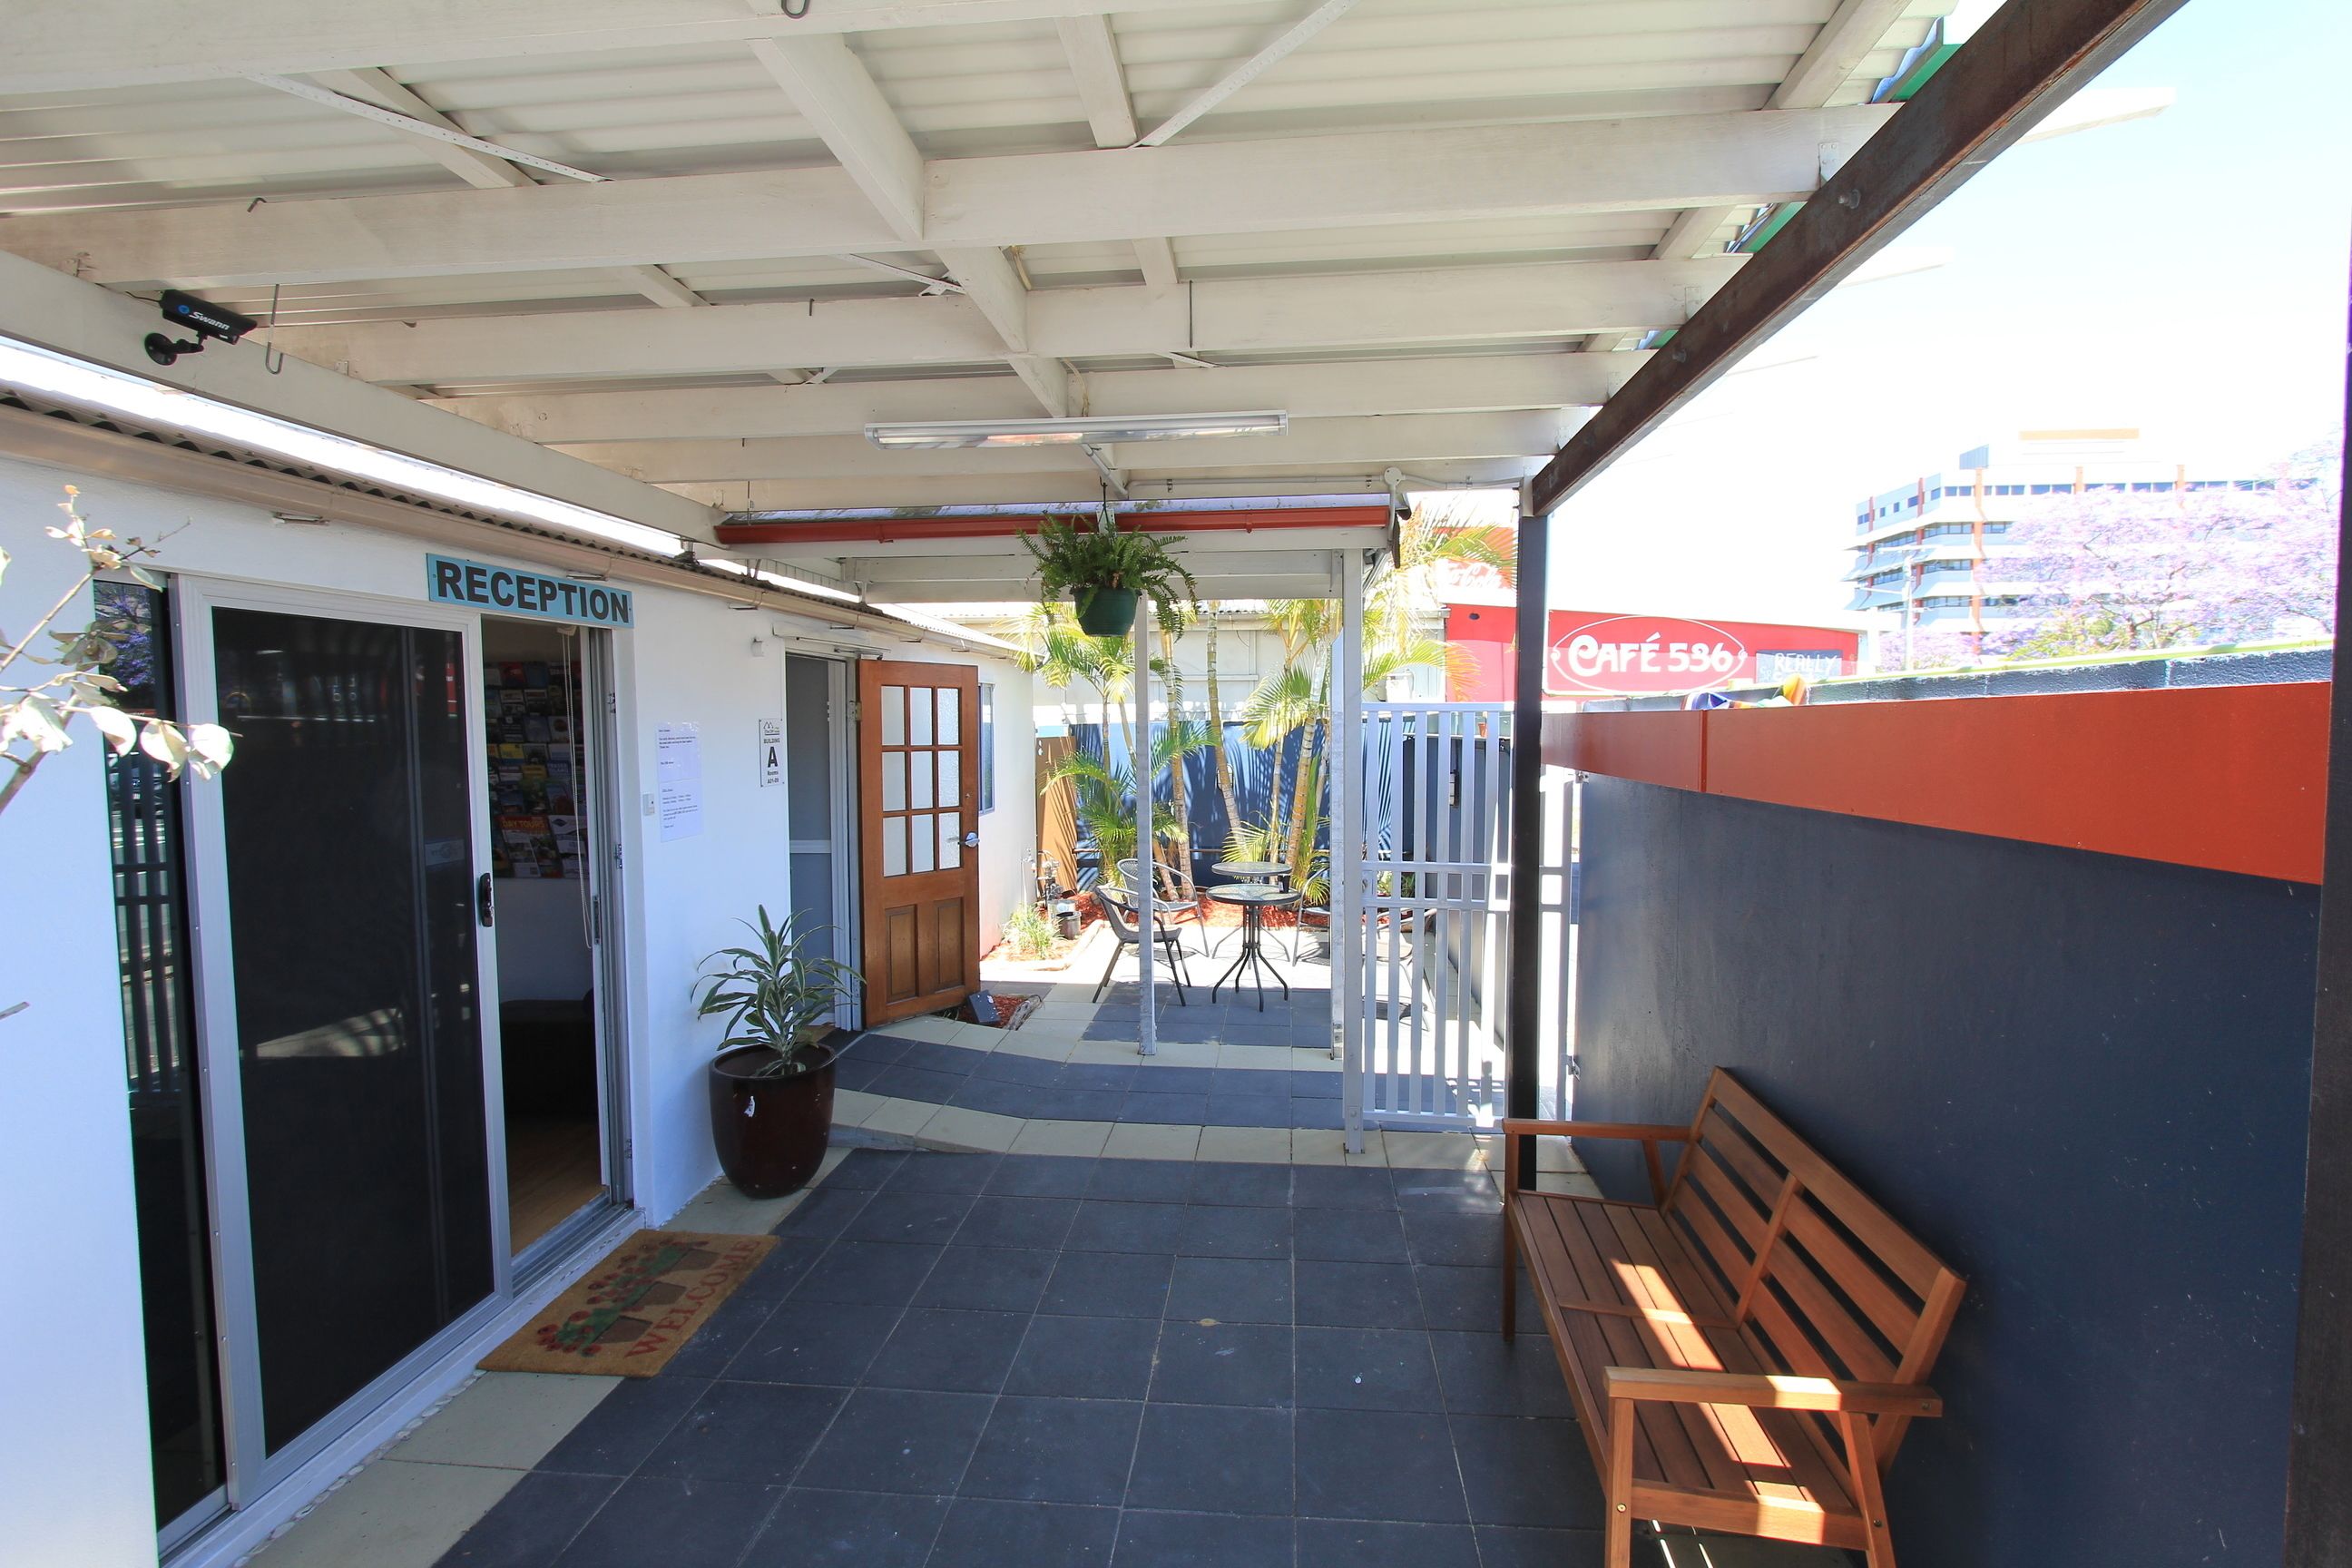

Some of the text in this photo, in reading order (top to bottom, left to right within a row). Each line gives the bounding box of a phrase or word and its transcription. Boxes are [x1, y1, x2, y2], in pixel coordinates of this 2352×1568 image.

[189, 311, 230, 330] Swann
[436, 560, 630, 623] RECEPTION
[1668, 642, 1734, 672] 536
[1773, 652, 1837, 675] REALLY
[768, 746, 779, 768] A
[503, 820, 546, 829] DAY TOURS
[624, 1240, 761, 1358] WELCOME
